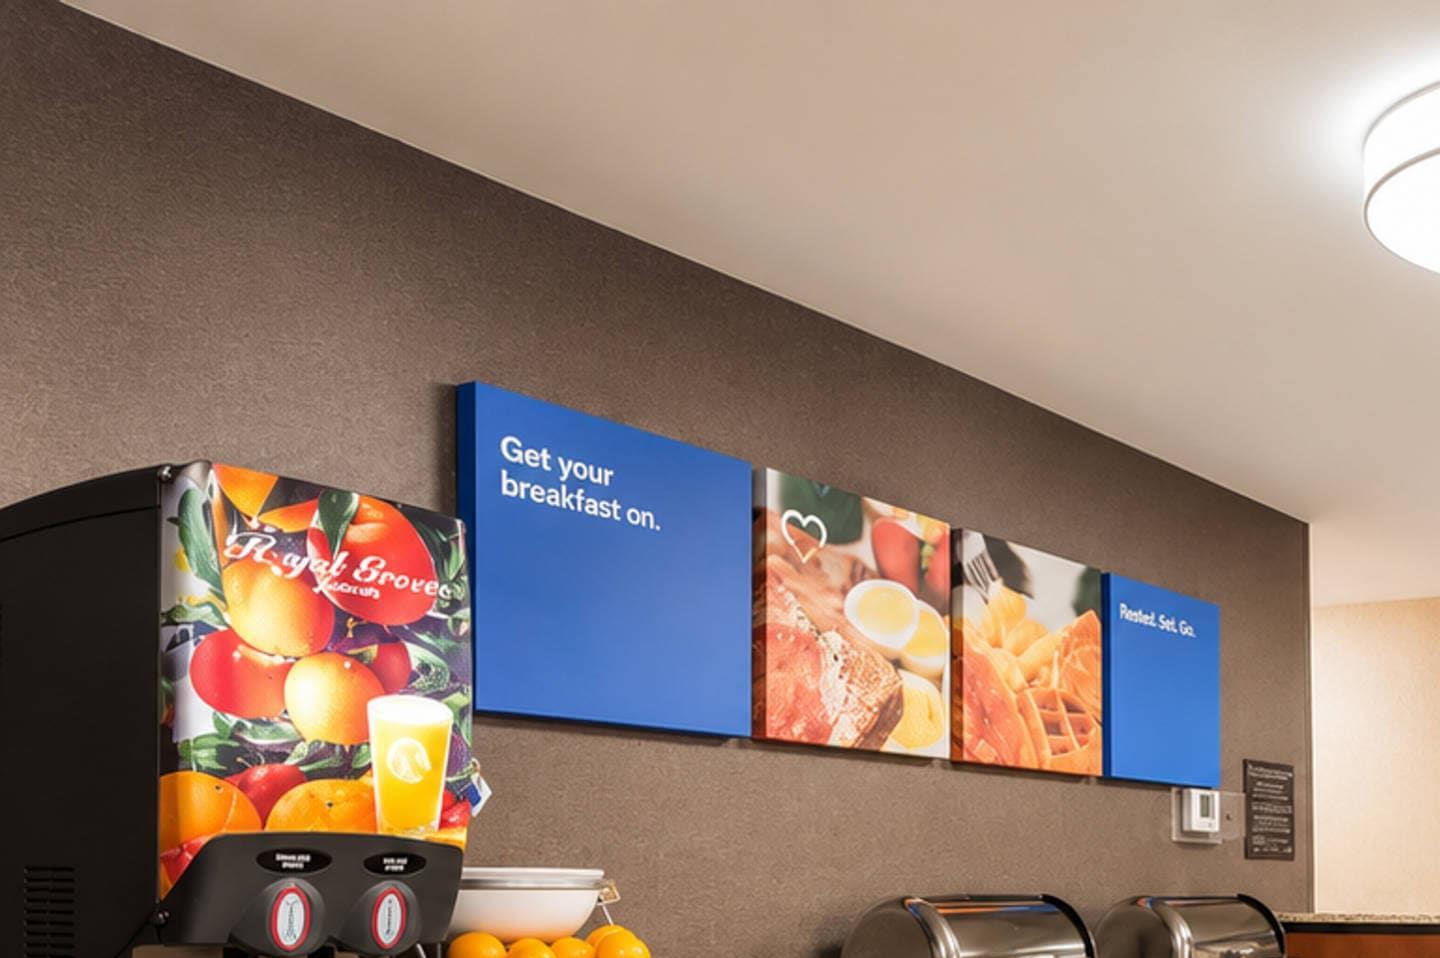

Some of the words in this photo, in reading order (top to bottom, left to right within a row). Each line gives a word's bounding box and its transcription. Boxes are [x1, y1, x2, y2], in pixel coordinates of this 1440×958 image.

[500, 435, 551, 471] Get
[557, 456, 614, 487] your
[501, 469, 621, 521] breakfast
[626, 507, 661, 531] on.
[1119, 602, 1157, 627] Rested.
[1158, 613, 1178, 633] Set.
[1179, 620, 1197, 638] Go.
